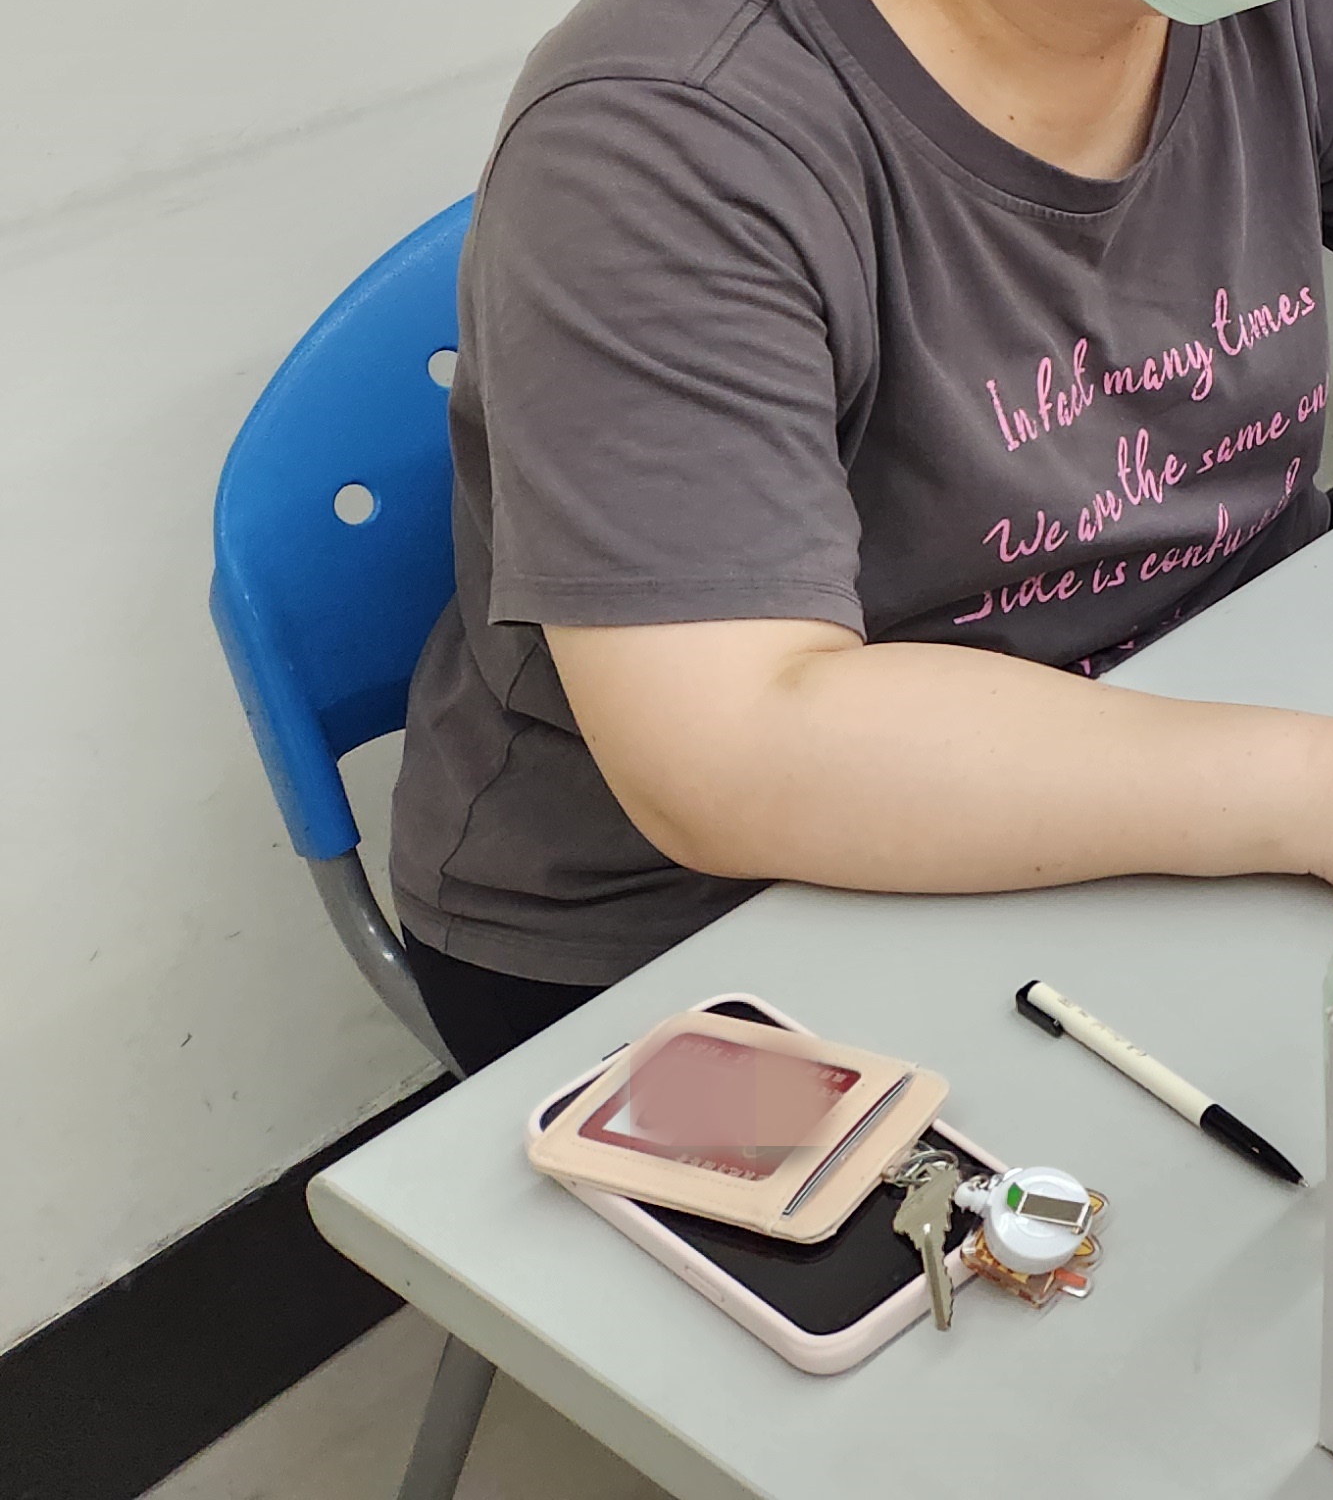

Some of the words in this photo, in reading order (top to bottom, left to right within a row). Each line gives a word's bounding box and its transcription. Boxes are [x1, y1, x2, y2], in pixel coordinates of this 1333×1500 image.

[1103, 340, 1214, 402] many
[982, 510, 1069, 563] We
[1077, 489, 1123, 543] are
[1118, 428, 1188, 505] the
[1195, 409, 1290, 474] same
[1297, 371, 1330, 424] on
[1092, 559, 1128, 594] is
